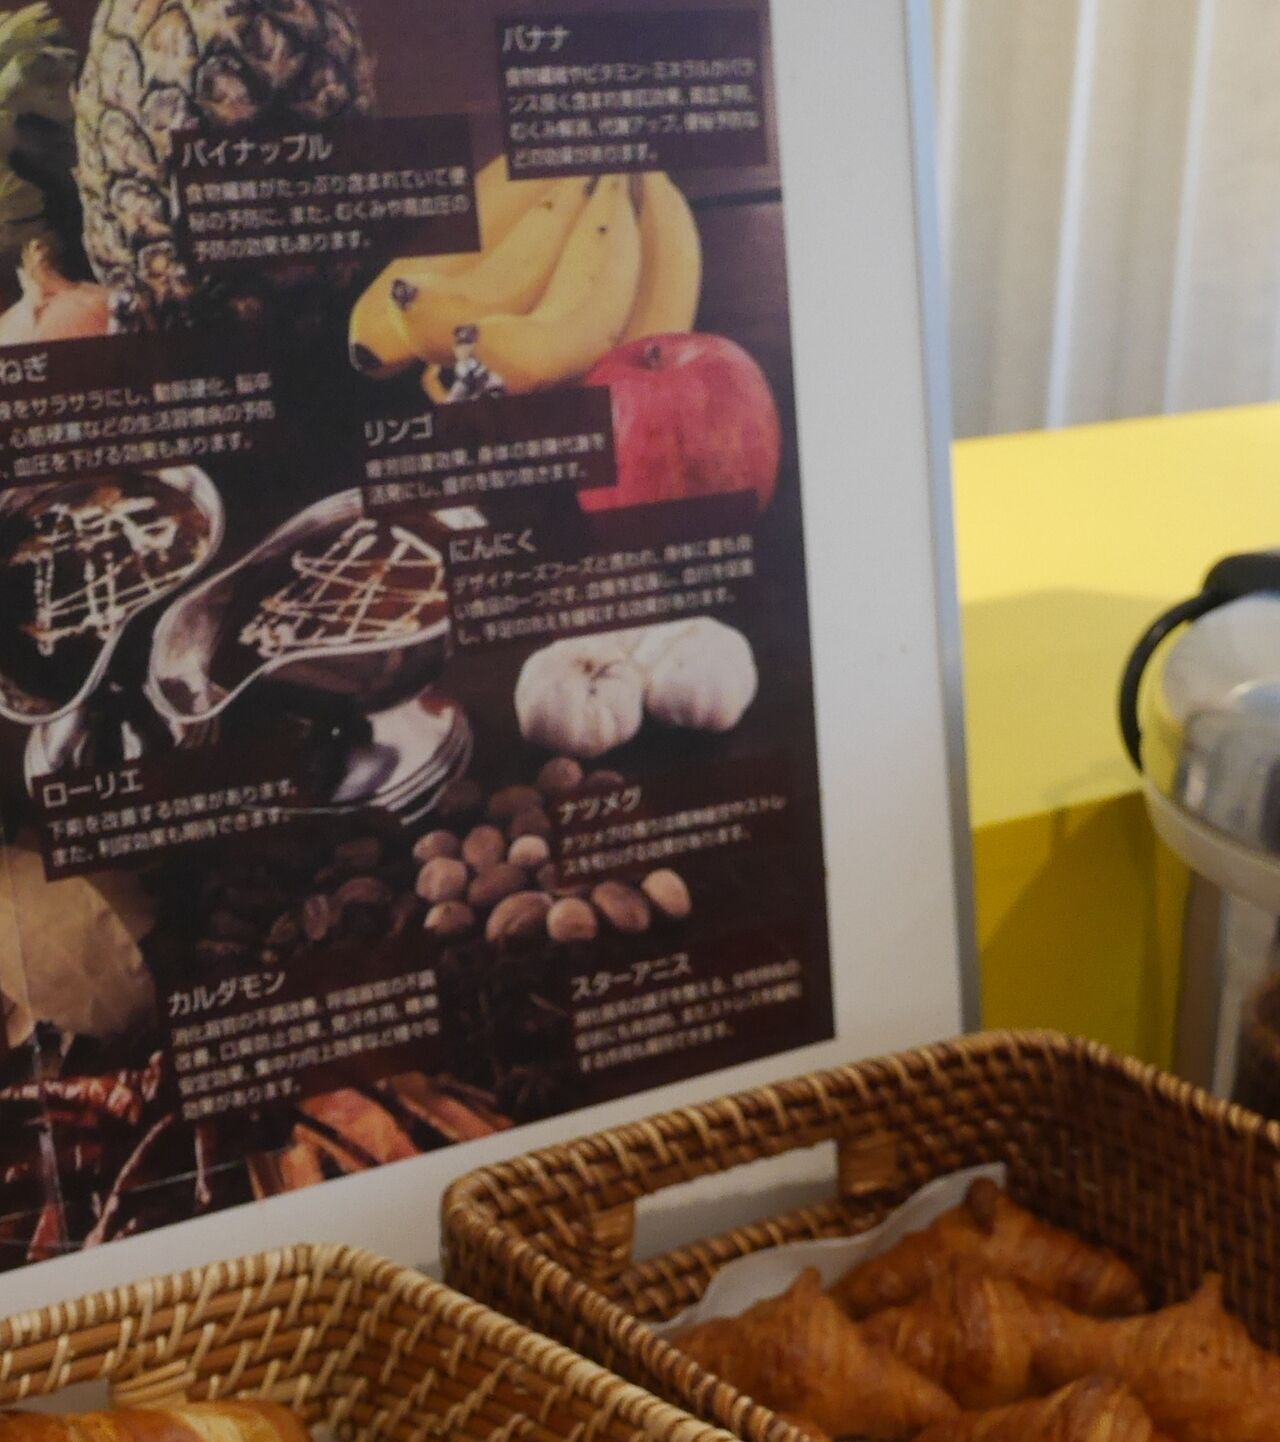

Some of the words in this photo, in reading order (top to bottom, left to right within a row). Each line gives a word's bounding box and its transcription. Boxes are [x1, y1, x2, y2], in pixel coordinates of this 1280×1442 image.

[364, 414, 433, 446] リンゴ
[449, 529, 536, 564] にんにく
[43, 768, 144, 809] ローリエ
[168, 971, 286, 1017] カルダモン
